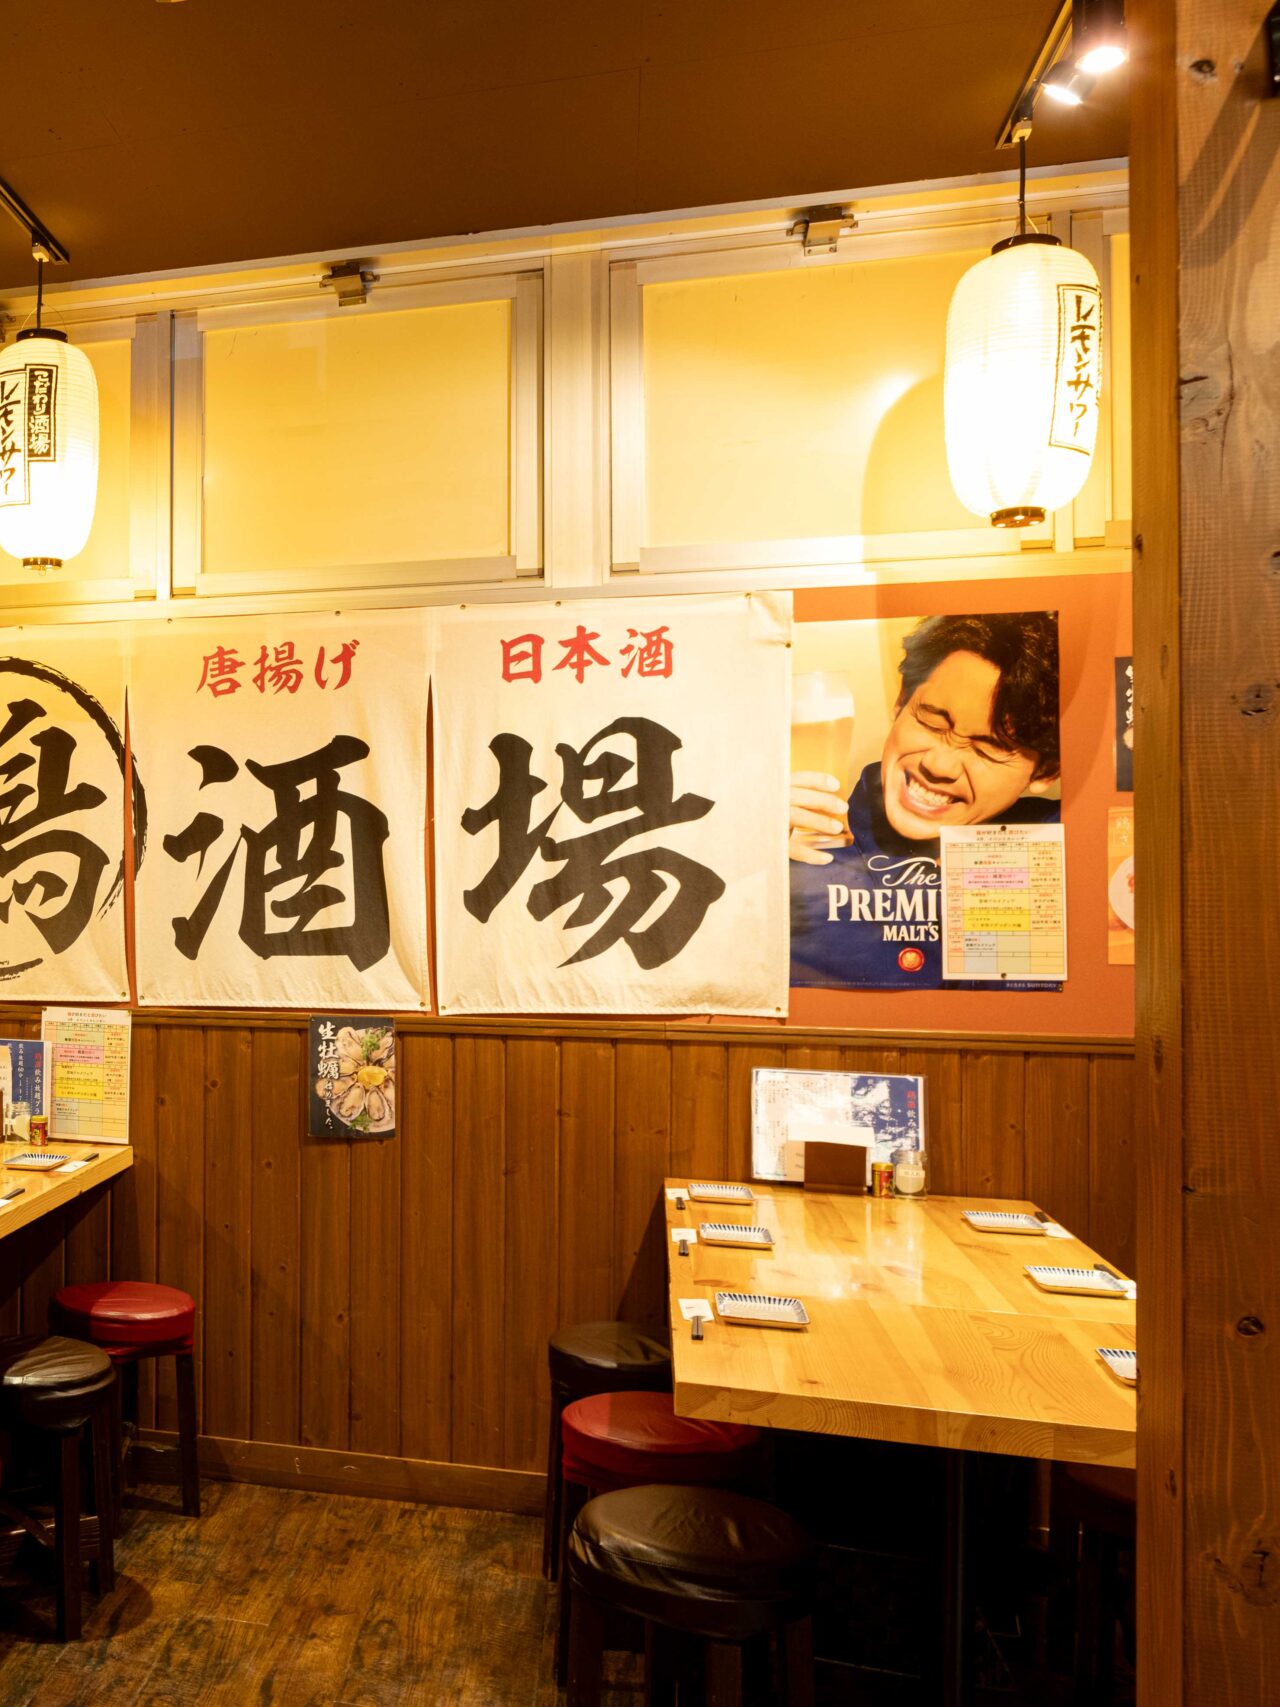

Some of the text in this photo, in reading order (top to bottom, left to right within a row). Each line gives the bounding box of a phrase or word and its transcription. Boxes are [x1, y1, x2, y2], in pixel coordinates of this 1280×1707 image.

[1067, 294, 1096, 437] レモンサワー
[29, 370, 50, 456] こだわり酒場
[197, 638, 361, 699] 唐揚げ
[500, 624, 676, 685] 日本酒
[867, 855, 942, 887] The
[827, 884, 942, 922] PREMI
[883, 921, 939, 941] MALT'S
